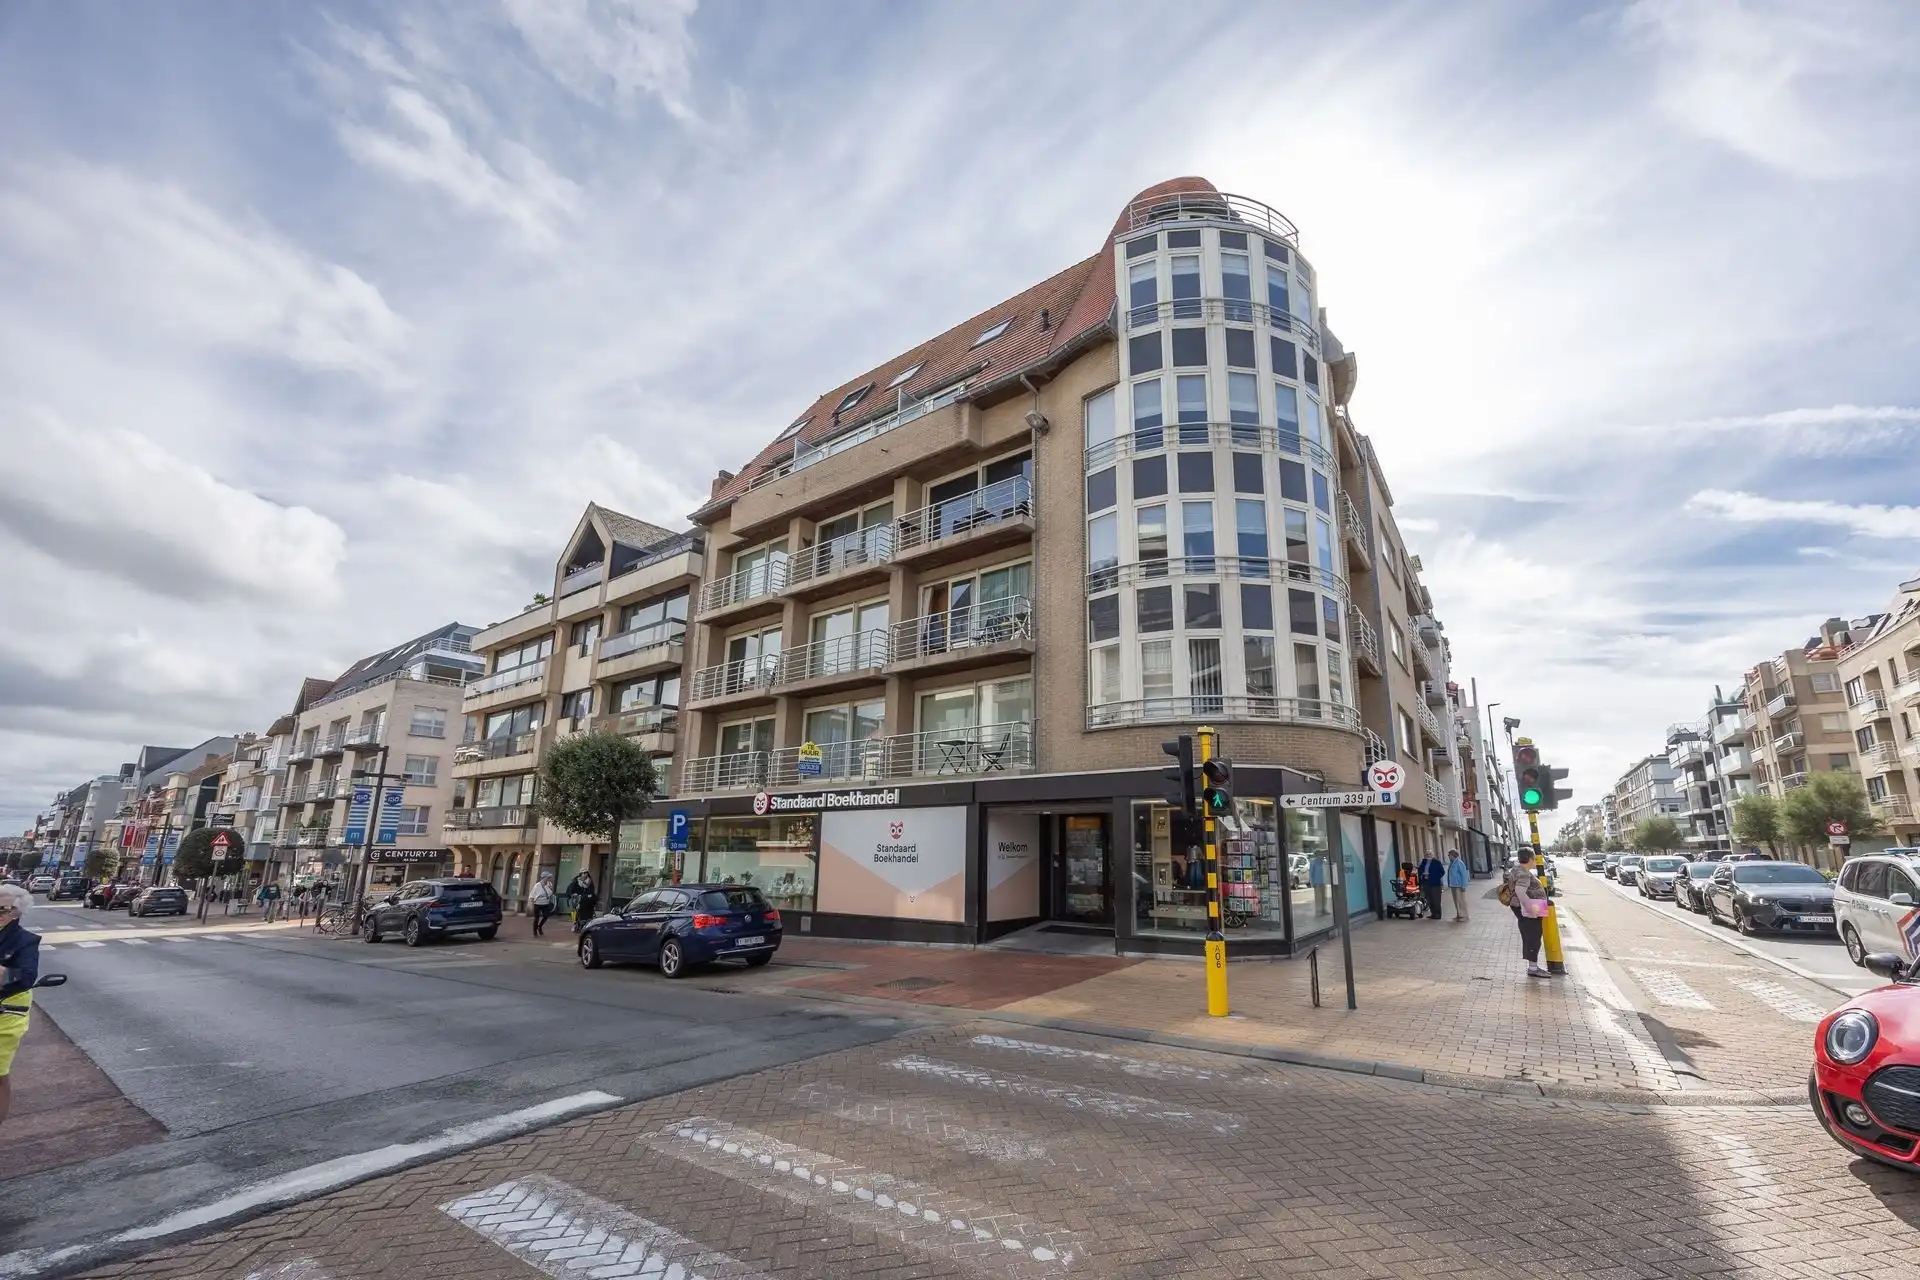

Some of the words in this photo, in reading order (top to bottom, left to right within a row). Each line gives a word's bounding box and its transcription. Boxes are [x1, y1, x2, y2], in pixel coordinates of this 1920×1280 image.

[770, 793, 826, 810] Standaard
[827, 789, 900, 807] Boekhandel
[1301, 795, 1341, 806] Centrum
[1344, 793, 1363, 804] 339
[1367, 793, 1376, 805] pl
[673, 814, 686, 834] P
[876, 843, 917, 853] Standaard
[998, 842, 1028, 852] Welkom
[385, 850, 427, 858] CENTURY
[427, 850, 437, 858] 21
[873, 854, 919, 863] Boekhandel
[1214, 945, 1222, 968] A06
